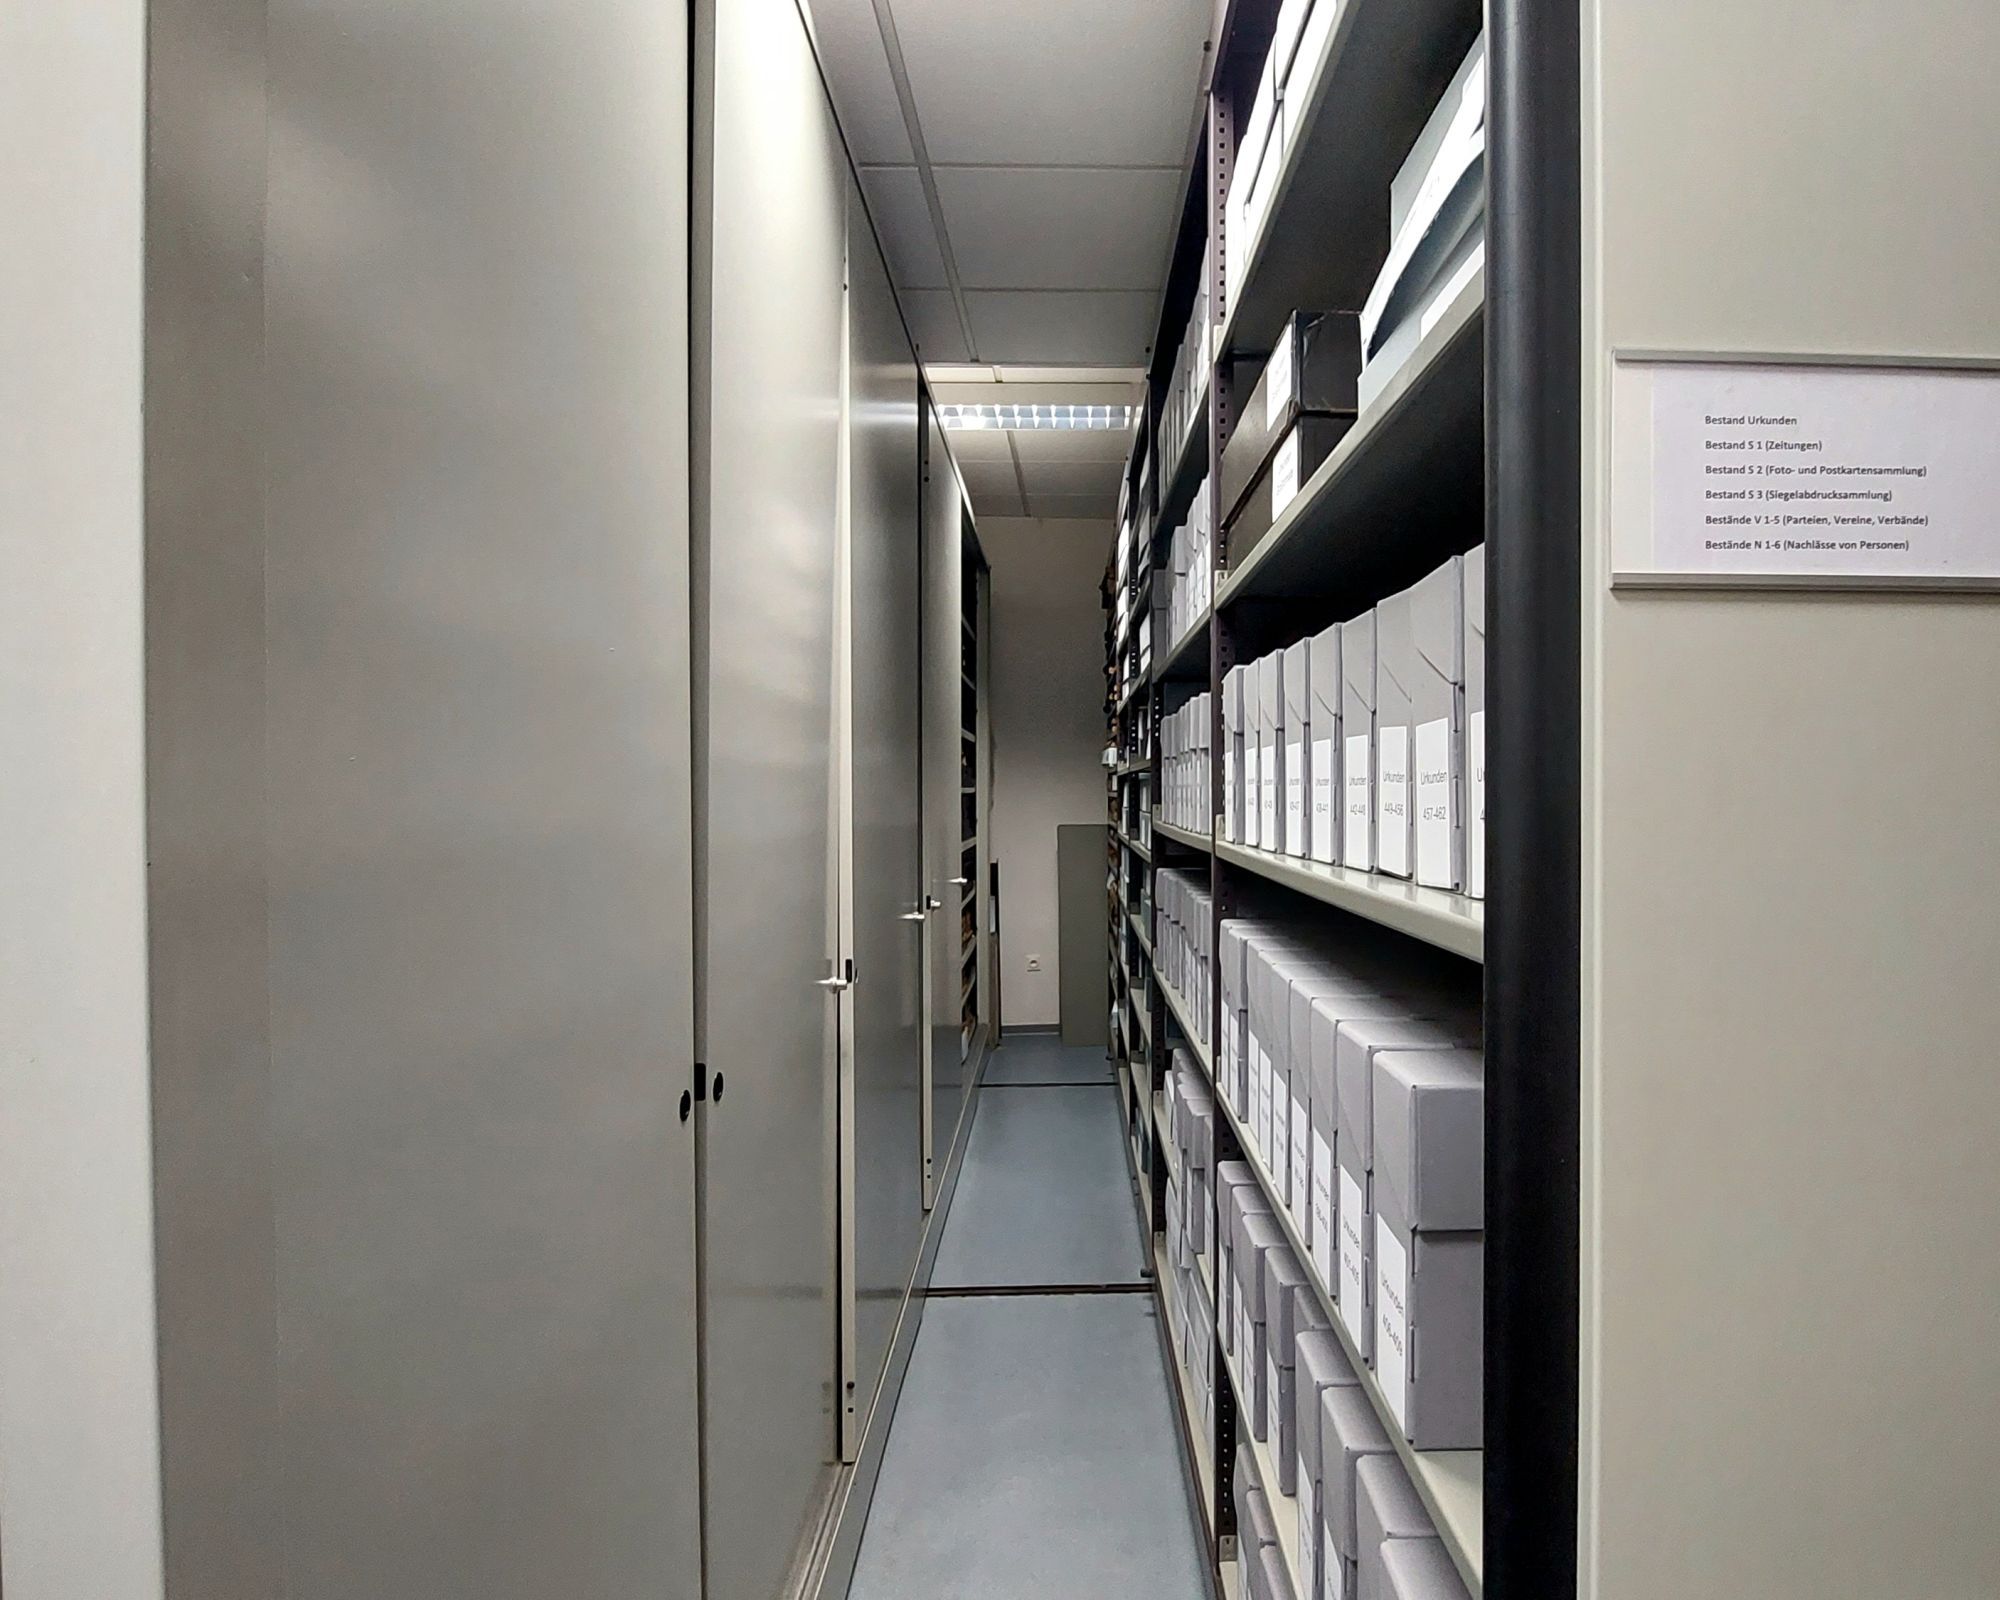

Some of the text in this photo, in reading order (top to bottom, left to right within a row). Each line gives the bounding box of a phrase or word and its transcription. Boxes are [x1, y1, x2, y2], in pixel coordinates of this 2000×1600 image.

[1704, 414, 1798, 426] Bestand Urkunden
[1705, 440, 1823, 452] Bestand S 1 (Zeitungen)
[1705, 464, 1928, 477] Bestand S 2 (Foto- und Postkartensammlung)
[1705, 489, 1893, 502] Bestand S 3 (Siegelabdrucksammlung)
[1705, 515, 1929, 527] Bestände V 1-5 (Parteien, Vereine, Verbände)
[1705, 540, 1910, 552] Bestände N 1-6 (Nachlässe von Personen)
[1420, 769, 1447, 785] Urkunden
